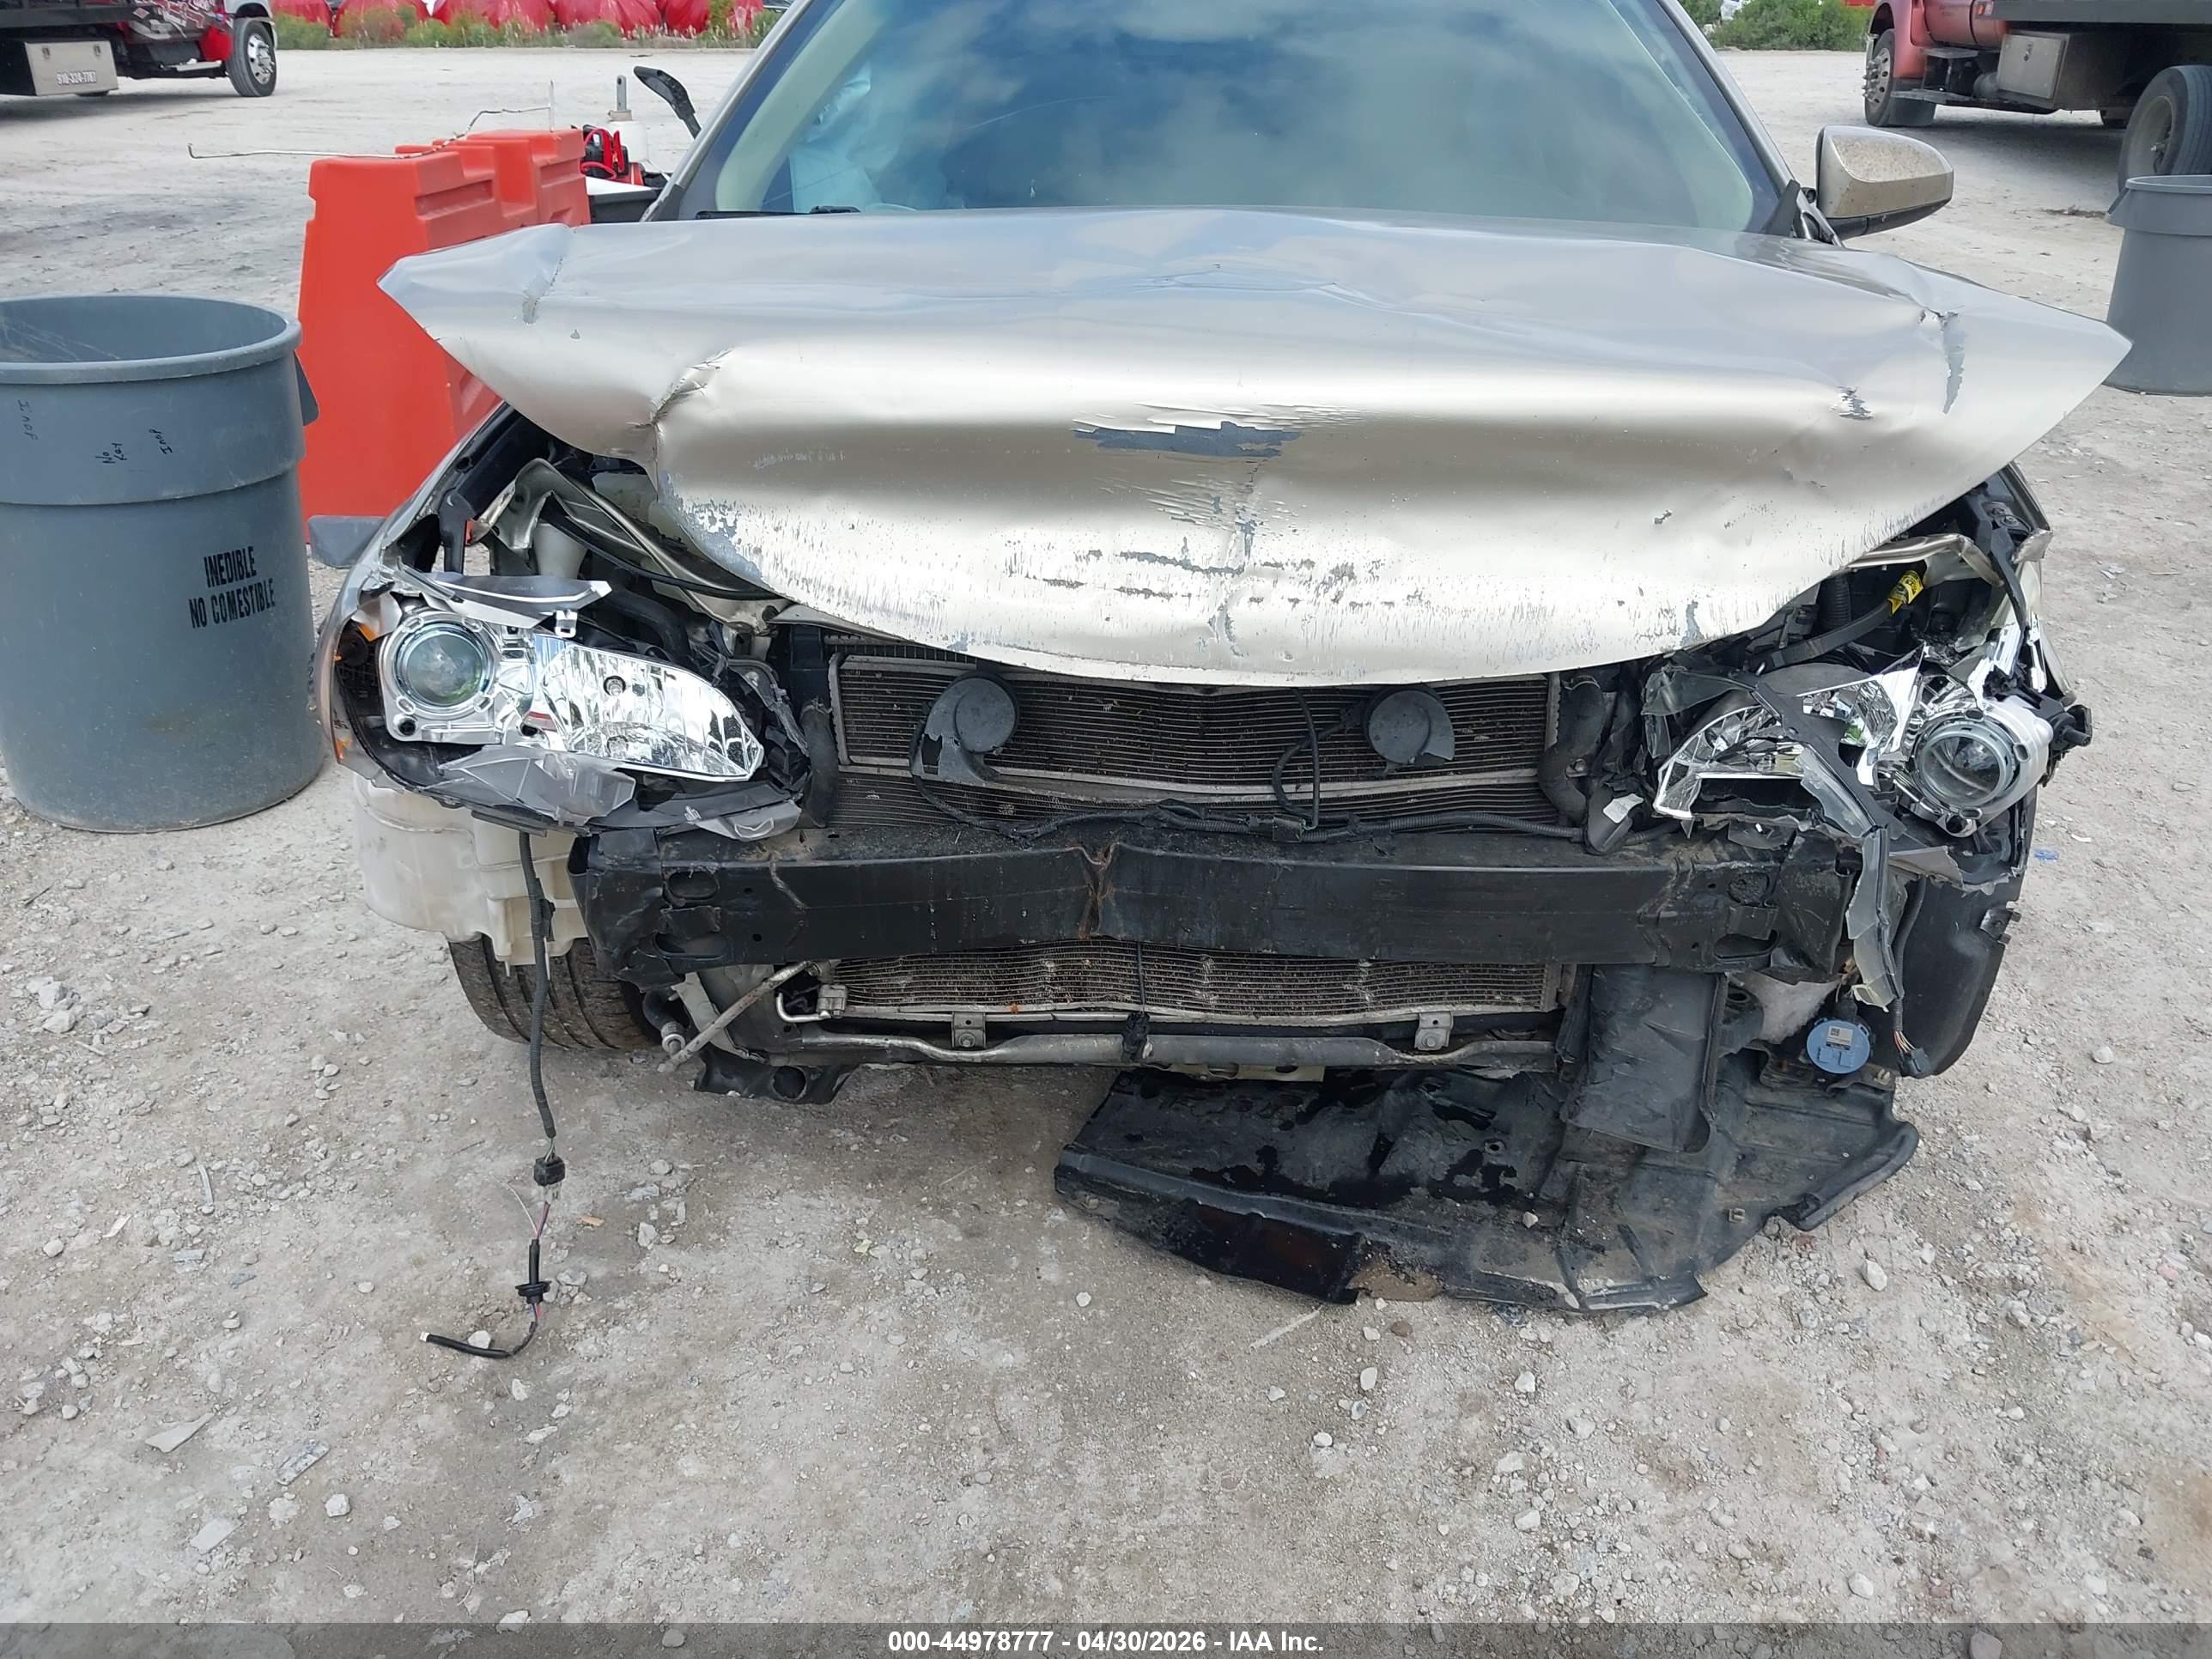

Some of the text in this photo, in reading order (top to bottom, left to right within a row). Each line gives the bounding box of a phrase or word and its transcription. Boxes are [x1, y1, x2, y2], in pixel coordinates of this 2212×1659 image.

[204, 546, 257, 588] INEDIBLE
[188, 577, 276, 629] NO COMESTIBLE
